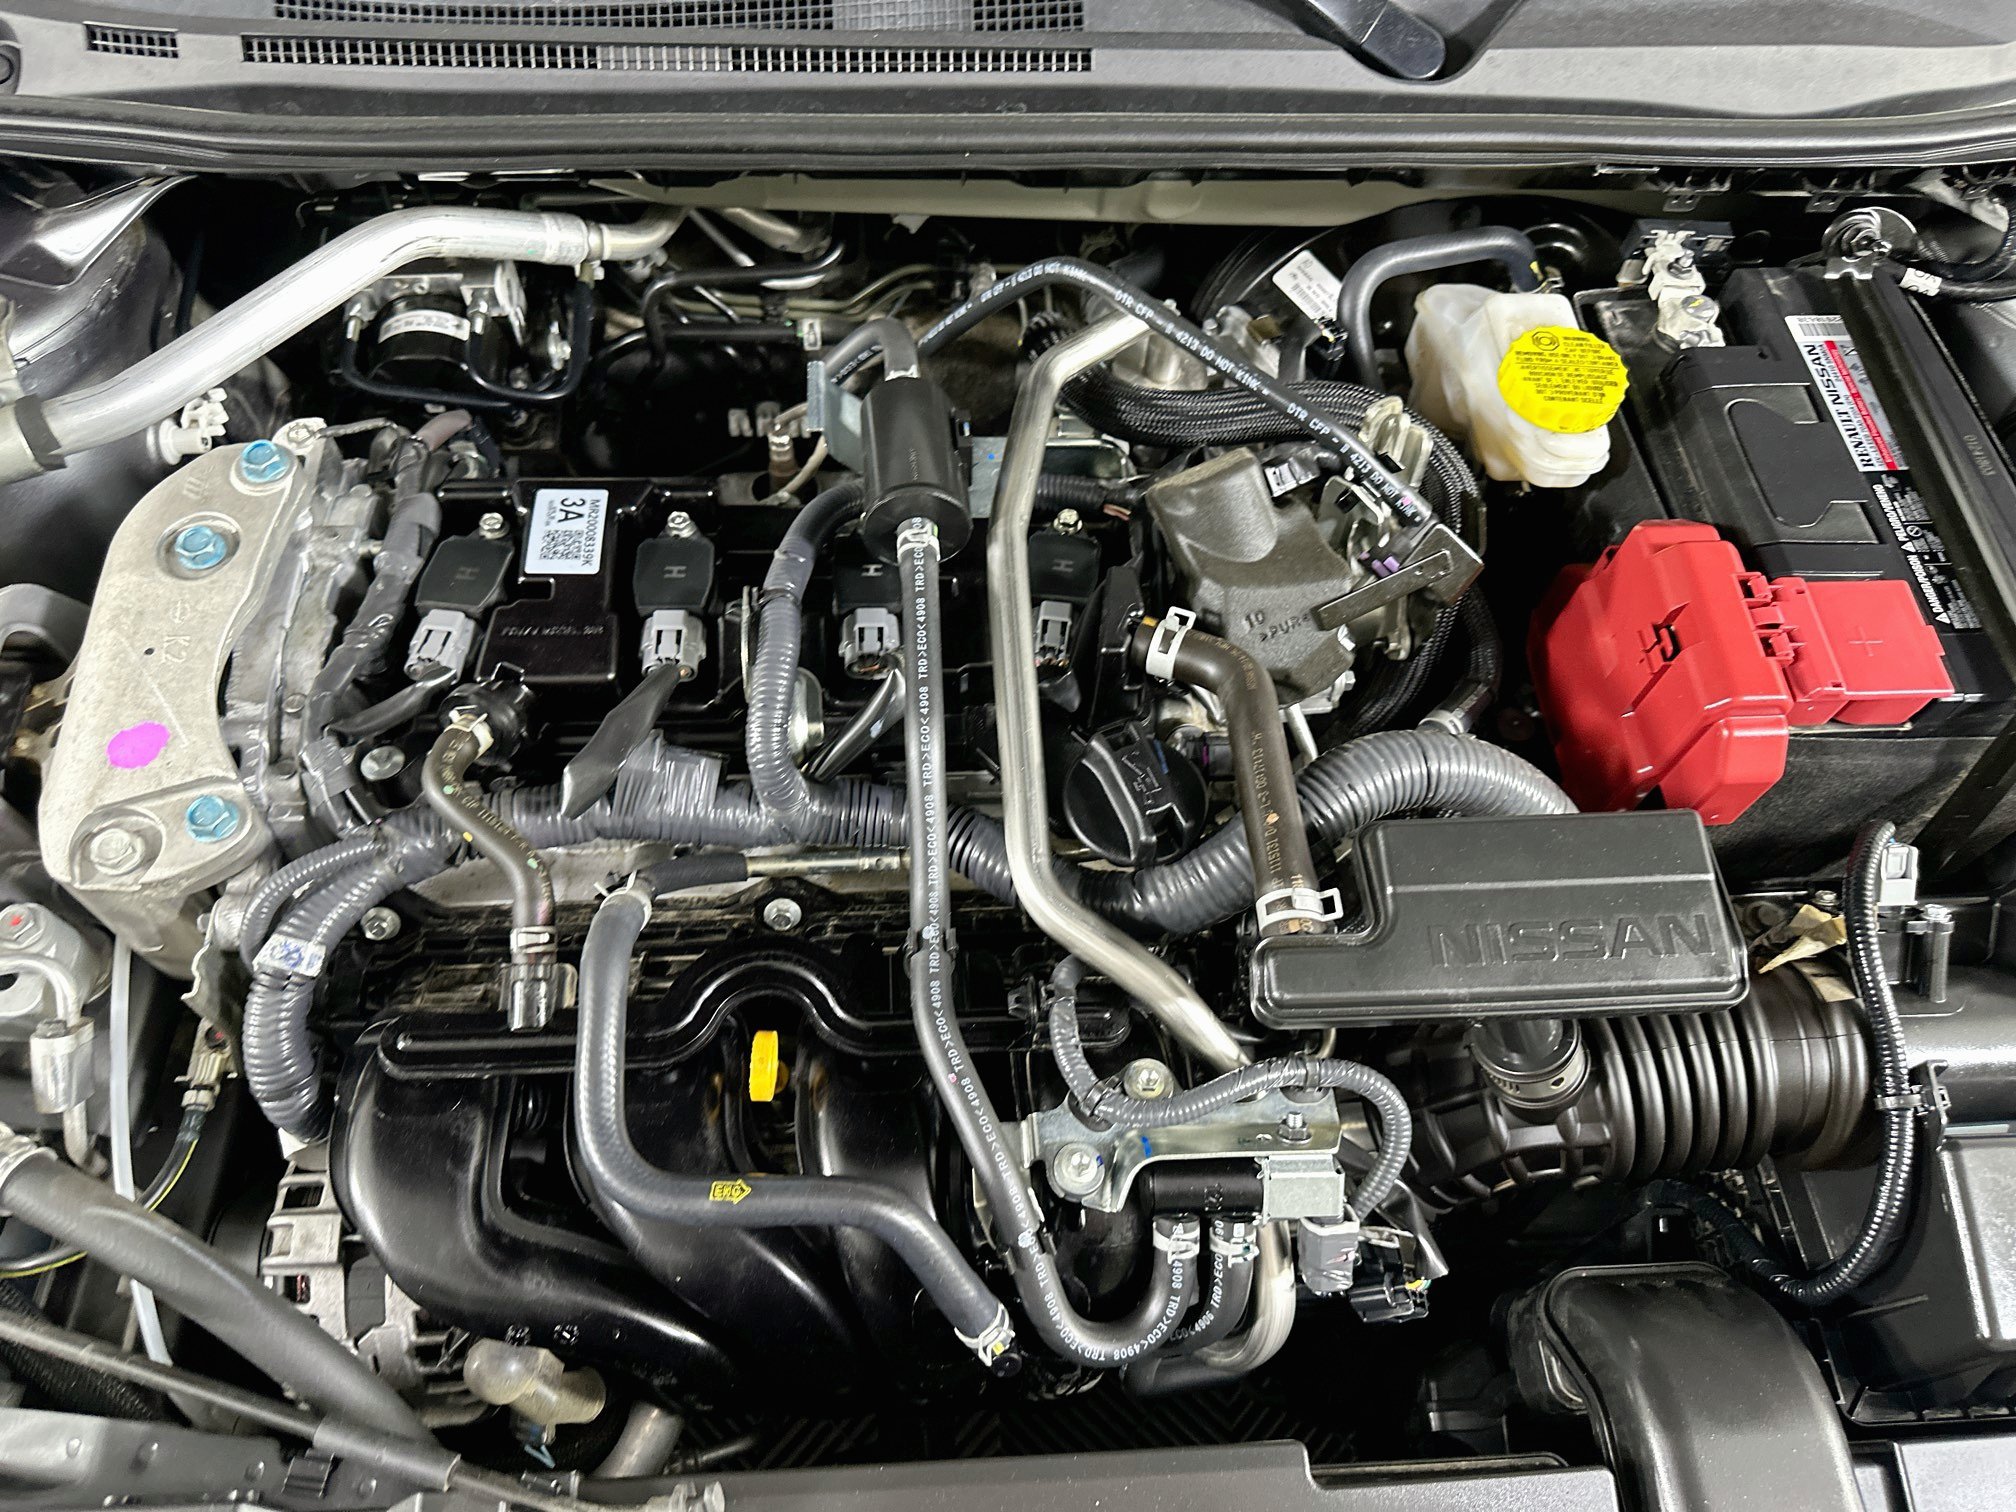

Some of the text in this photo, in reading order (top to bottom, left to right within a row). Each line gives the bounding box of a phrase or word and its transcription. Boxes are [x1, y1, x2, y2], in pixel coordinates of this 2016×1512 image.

[1175, 330, 1200, 351] 4213
[1200, 346, 1216, 361] DO
[1215, 356, 1235, 373] NOT
[1804, 344, 1844, 405] NISSAN
[1286, 403, 1308, 421] DTR
[1309, 417, 1331, 435] CFP
[1350, 453, 1371, 474] 4213
[1369, 471, 1383, 485] DO
[1380, 483, 1400, 498] NOT
[1836, 408, 1875, 468] RENAULT
[558, 497, 586, 523] 3A
[1872, 484, 1910, 542] PELIGRO/VENENO
[1906, 555, 1944, 613] DANGER/POISON
[1427, 913, 1716, 967] NISSAN
